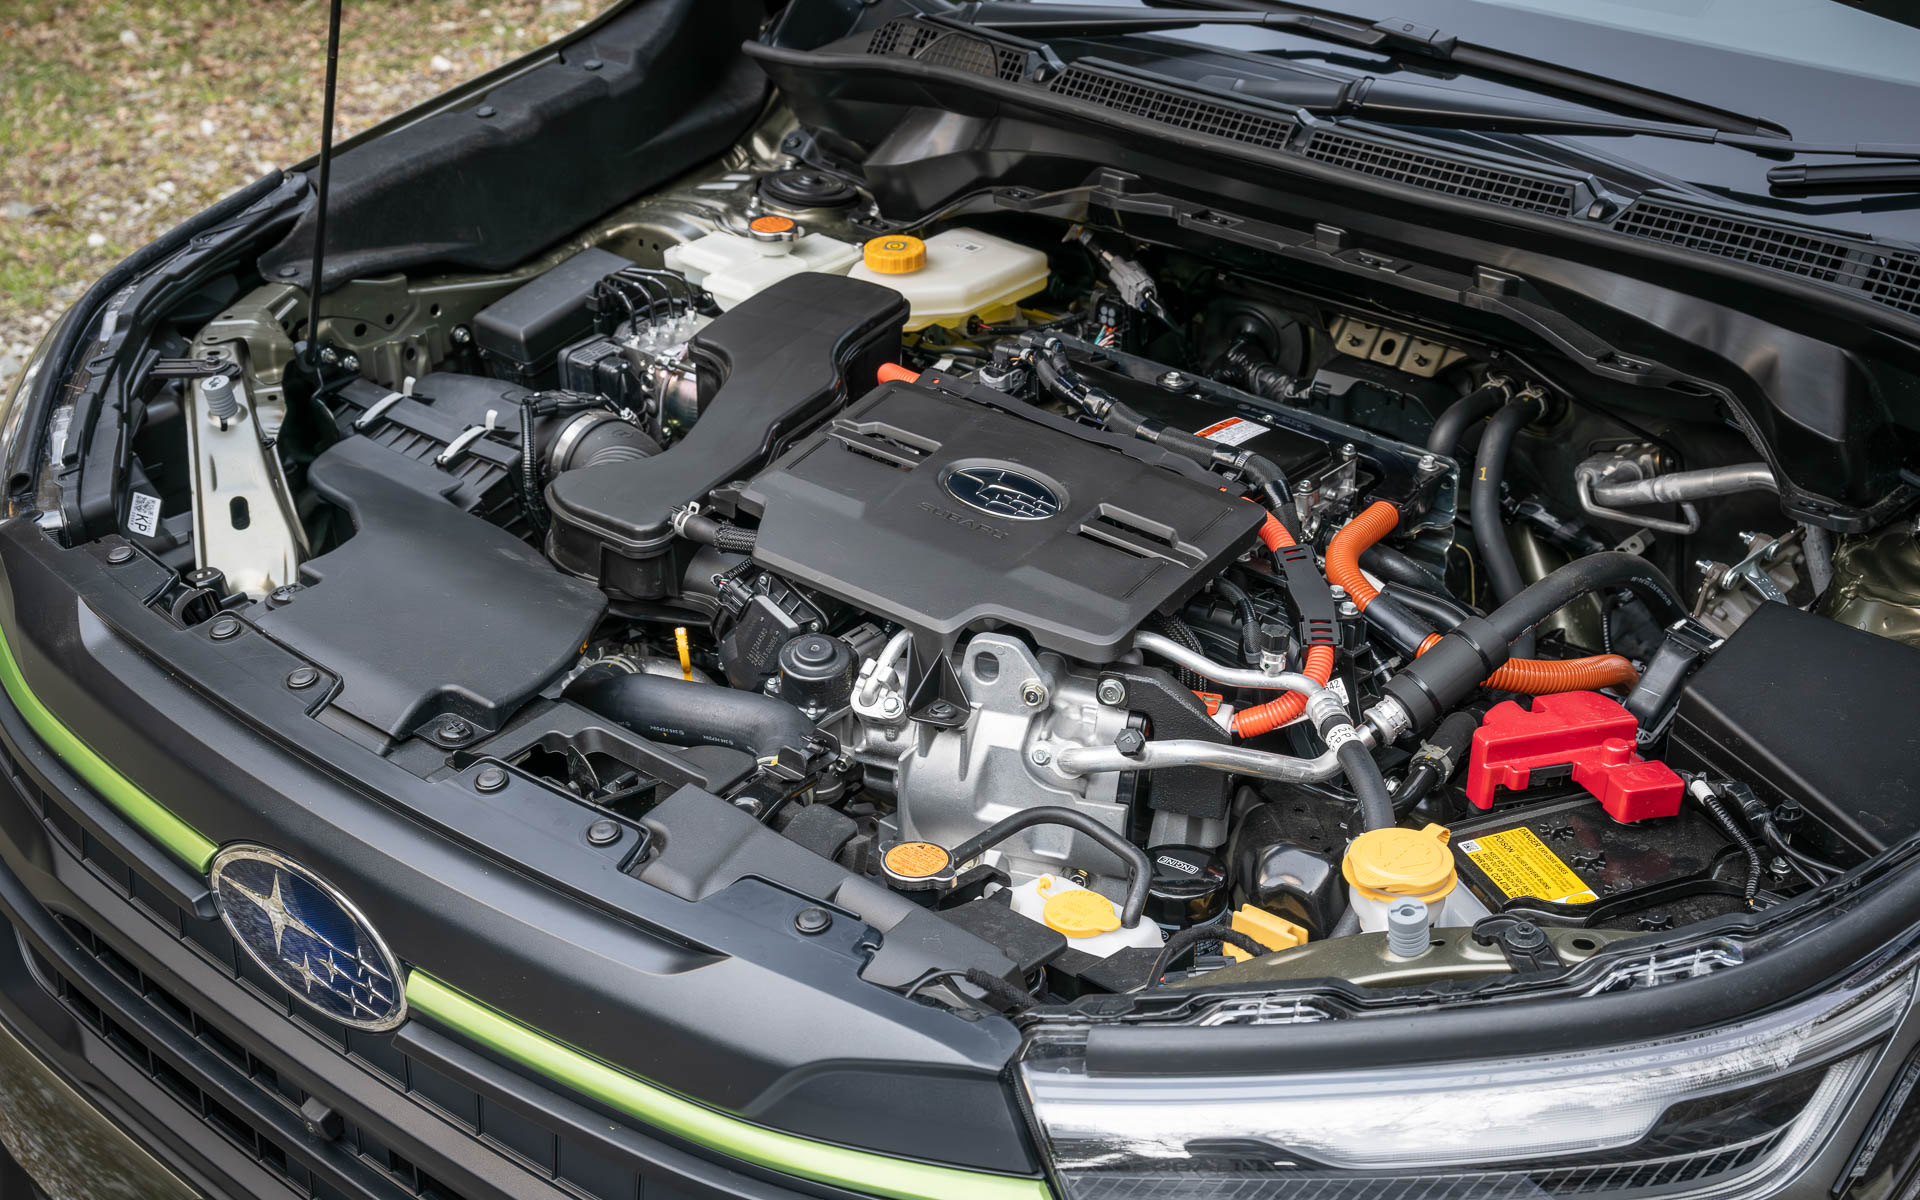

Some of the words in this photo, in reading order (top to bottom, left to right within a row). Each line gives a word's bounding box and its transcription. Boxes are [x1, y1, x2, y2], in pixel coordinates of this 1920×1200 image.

[135, 513, 149, 531] KP
[919, 502, 1009, 539] SUBARU
[1159, 856, 1197, 874] ENGINE
[1489, 851, 1500, 860] KEEP
[1493, 834, 1515, 853] POISON
[1513, 854, 1528, 867] CAUSES
[1525, 866, 1540, 879] SEVERE
[1518, 828, 1541, 848] DANGER
[1554, 862, 1569, 875] GASES
